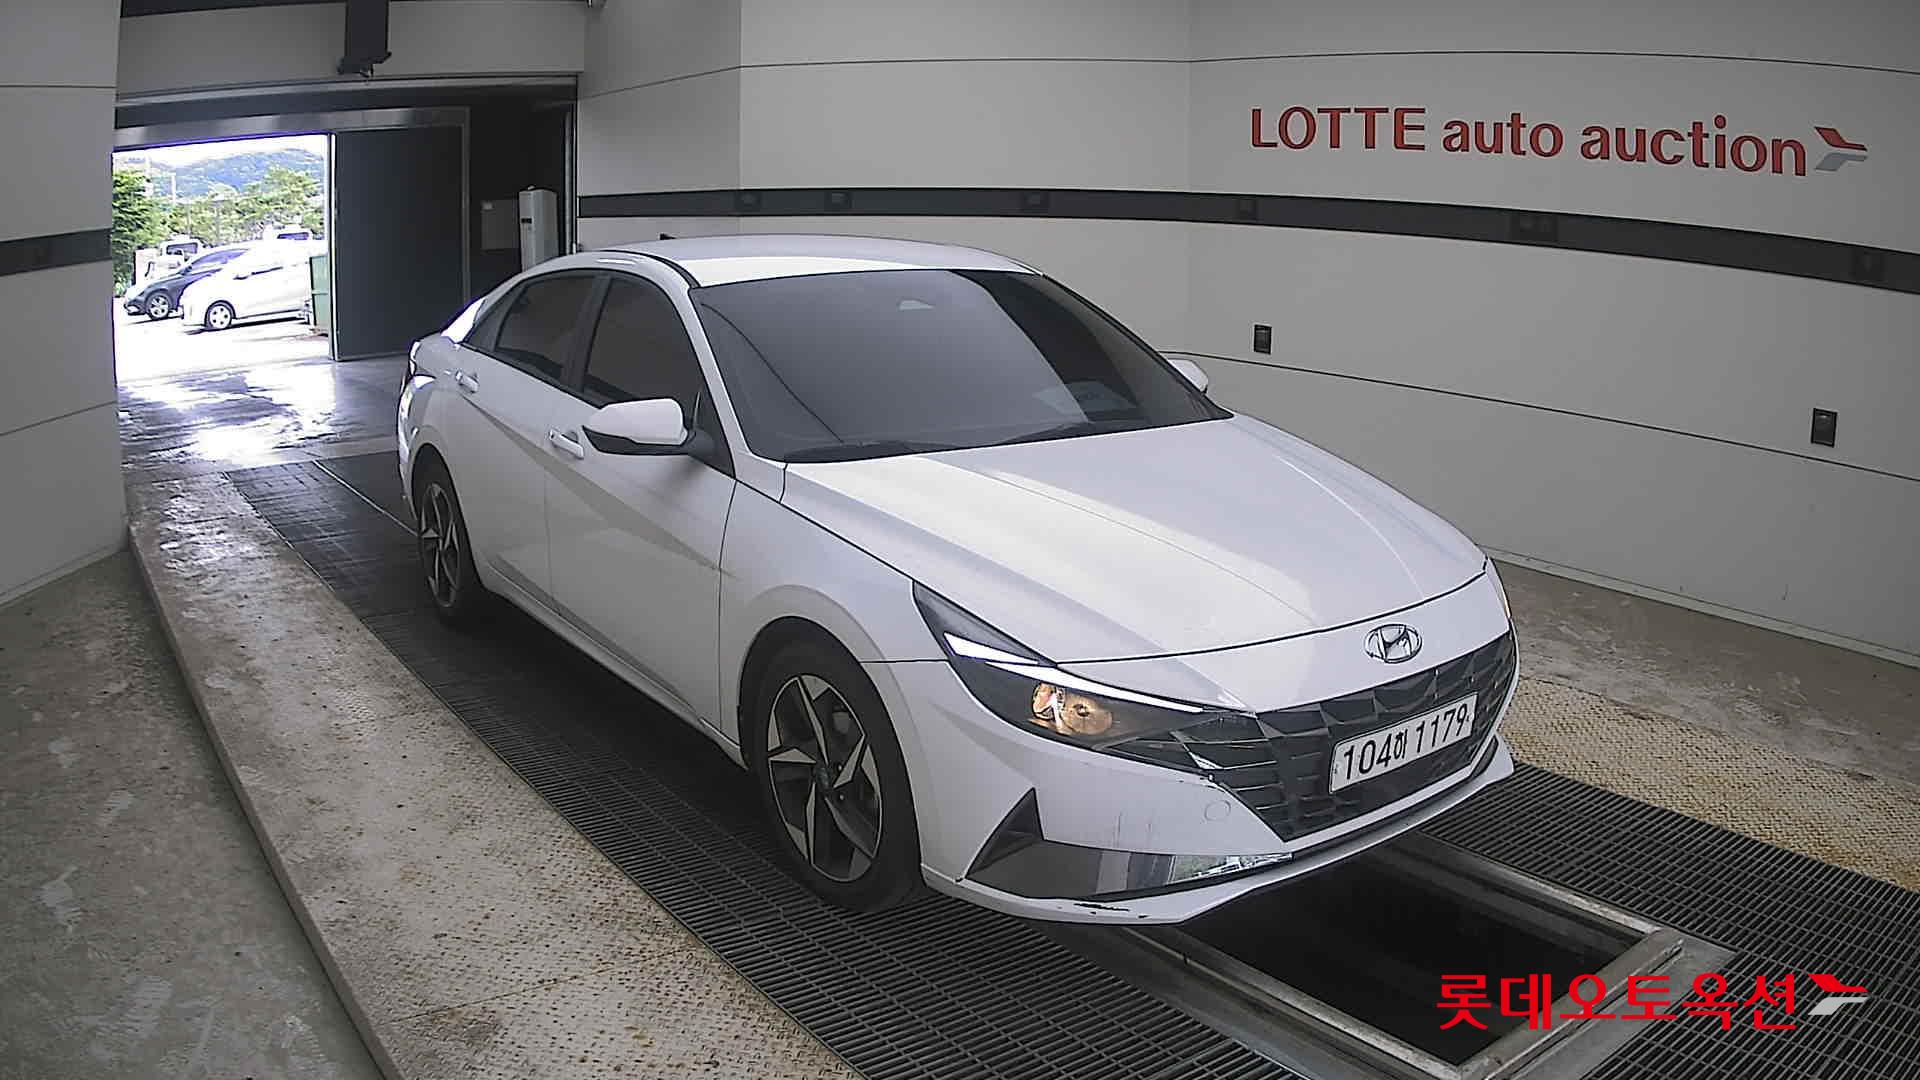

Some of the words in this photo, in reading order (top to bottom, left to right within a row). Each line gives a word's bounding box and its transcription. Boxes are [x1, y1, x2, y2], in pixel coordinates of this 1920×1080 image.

[1251, 106, 1427, 152] LOTTE
[1442, 112, 1564, 158] auto
[1580, 114, 1808, 178] auction
[1415, 702, 1469, 753] 1179
